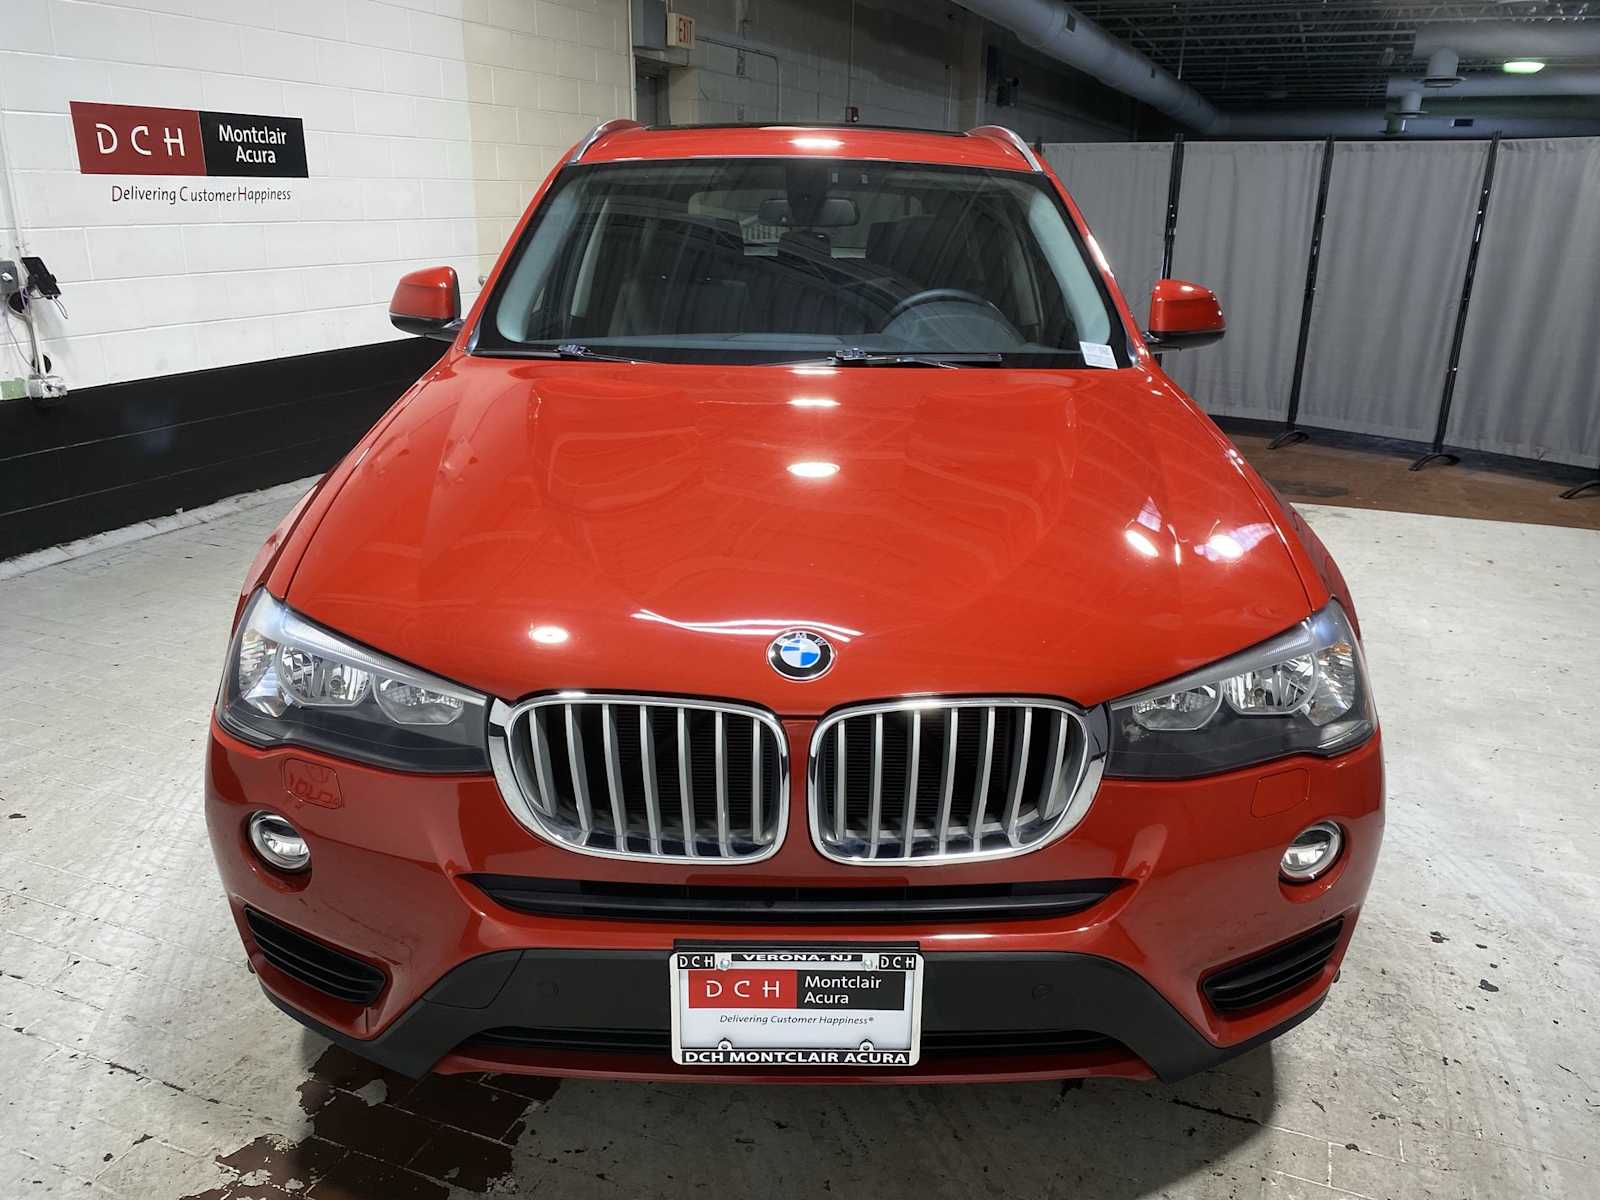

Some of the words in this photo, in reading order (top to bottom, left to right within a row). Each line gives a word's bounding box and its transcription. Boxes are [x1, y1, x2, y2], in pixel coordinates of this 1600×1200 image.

[95, 123, 185, 157] DCH
[219, 124, 287, 145] Montclair
[235, 146, 276, 164] Acura
[112, 185, 176, 205] Delivering
[179, 186, 237, 202] Customer
[238, 187, 292, 204] Happiness
[679, 955, 714, 968] DCH
[880, 956, 915, 968] DCH
[706, 980, 780, 998] DCH
[805, 975, 882, 990] Montclair
[804, 991, 849, 1005] Acura
[719, 1014, 768, 1026] Delivering
[770, 1014, 818, 1025] Customer
[685, 1051, 724, 1064] DCH
[729, 1051, 839, 1064] MONTCLAIR
[843, 1051, 907, 1065] ACURA
